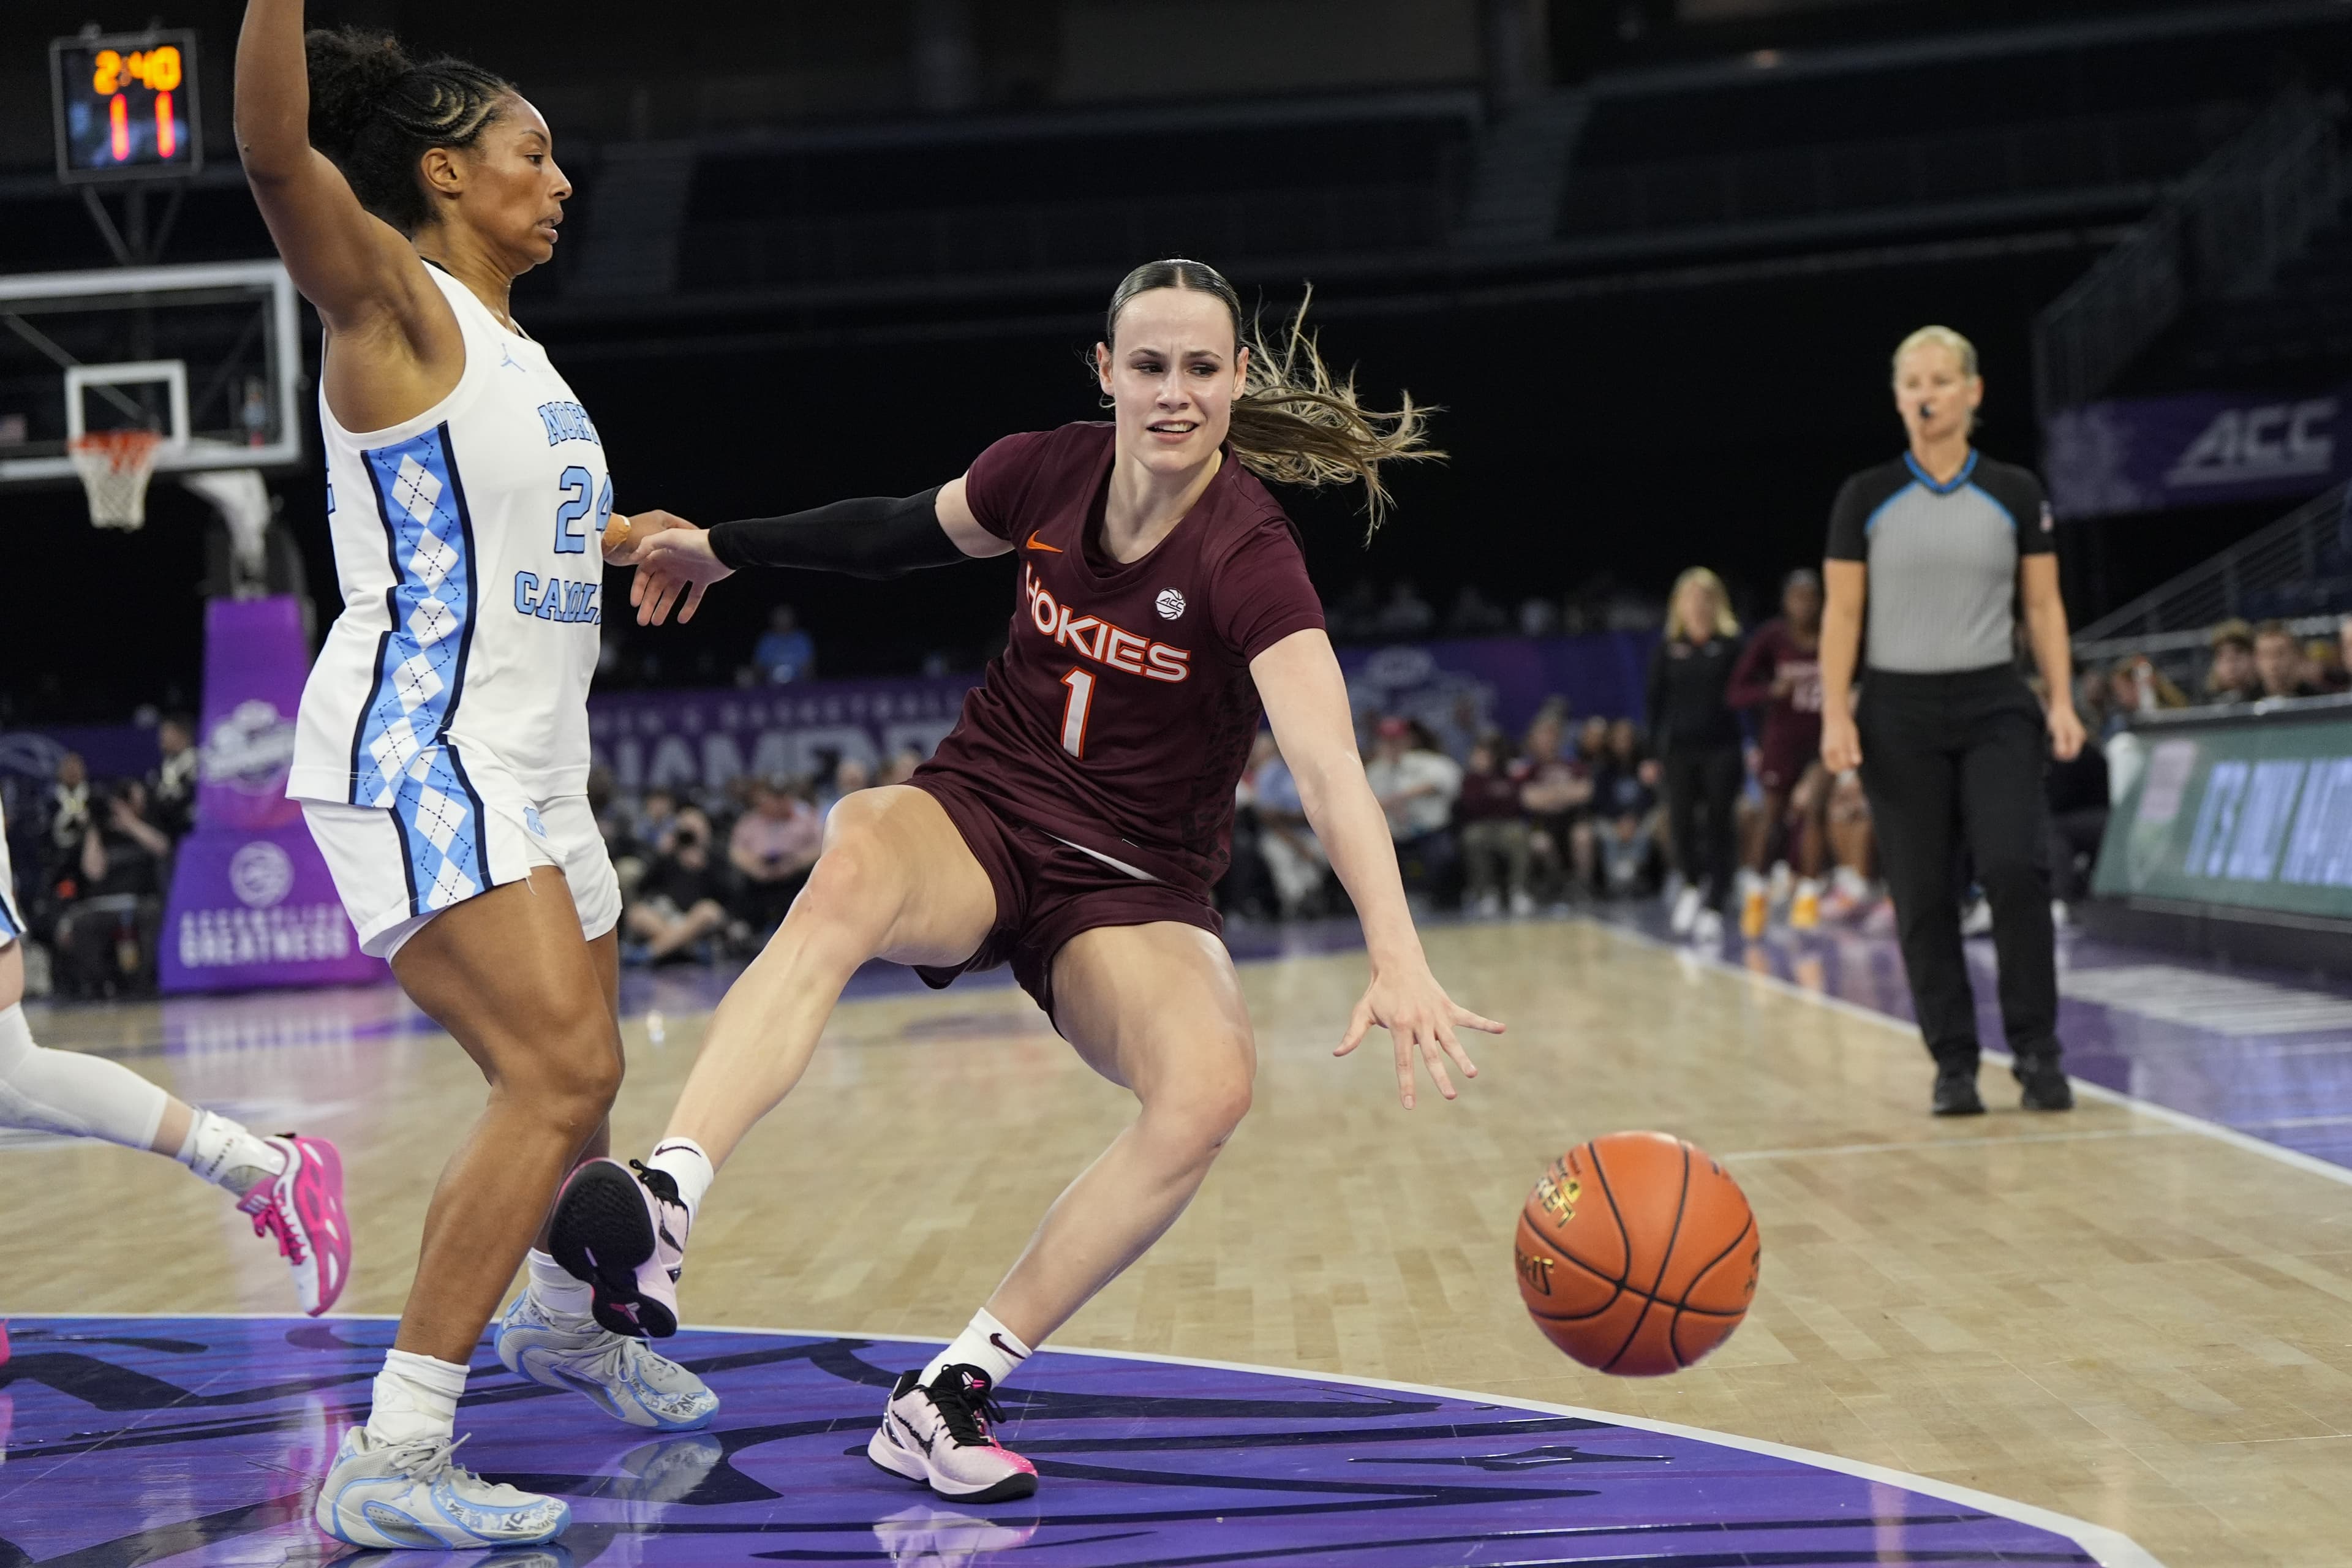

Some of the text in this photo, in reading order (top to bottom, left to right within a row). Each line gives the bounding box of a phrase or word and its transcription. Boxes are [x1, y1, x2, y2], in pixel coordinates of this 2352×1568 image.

[2163, 396, 2339, 487] ACC
[554, 466, 613, 554] 24
[1025, 560, 1191, 683] HOKIES
[1159, 597, 1184, 611] ACC
[1060, 666, 1096, 761] 1
